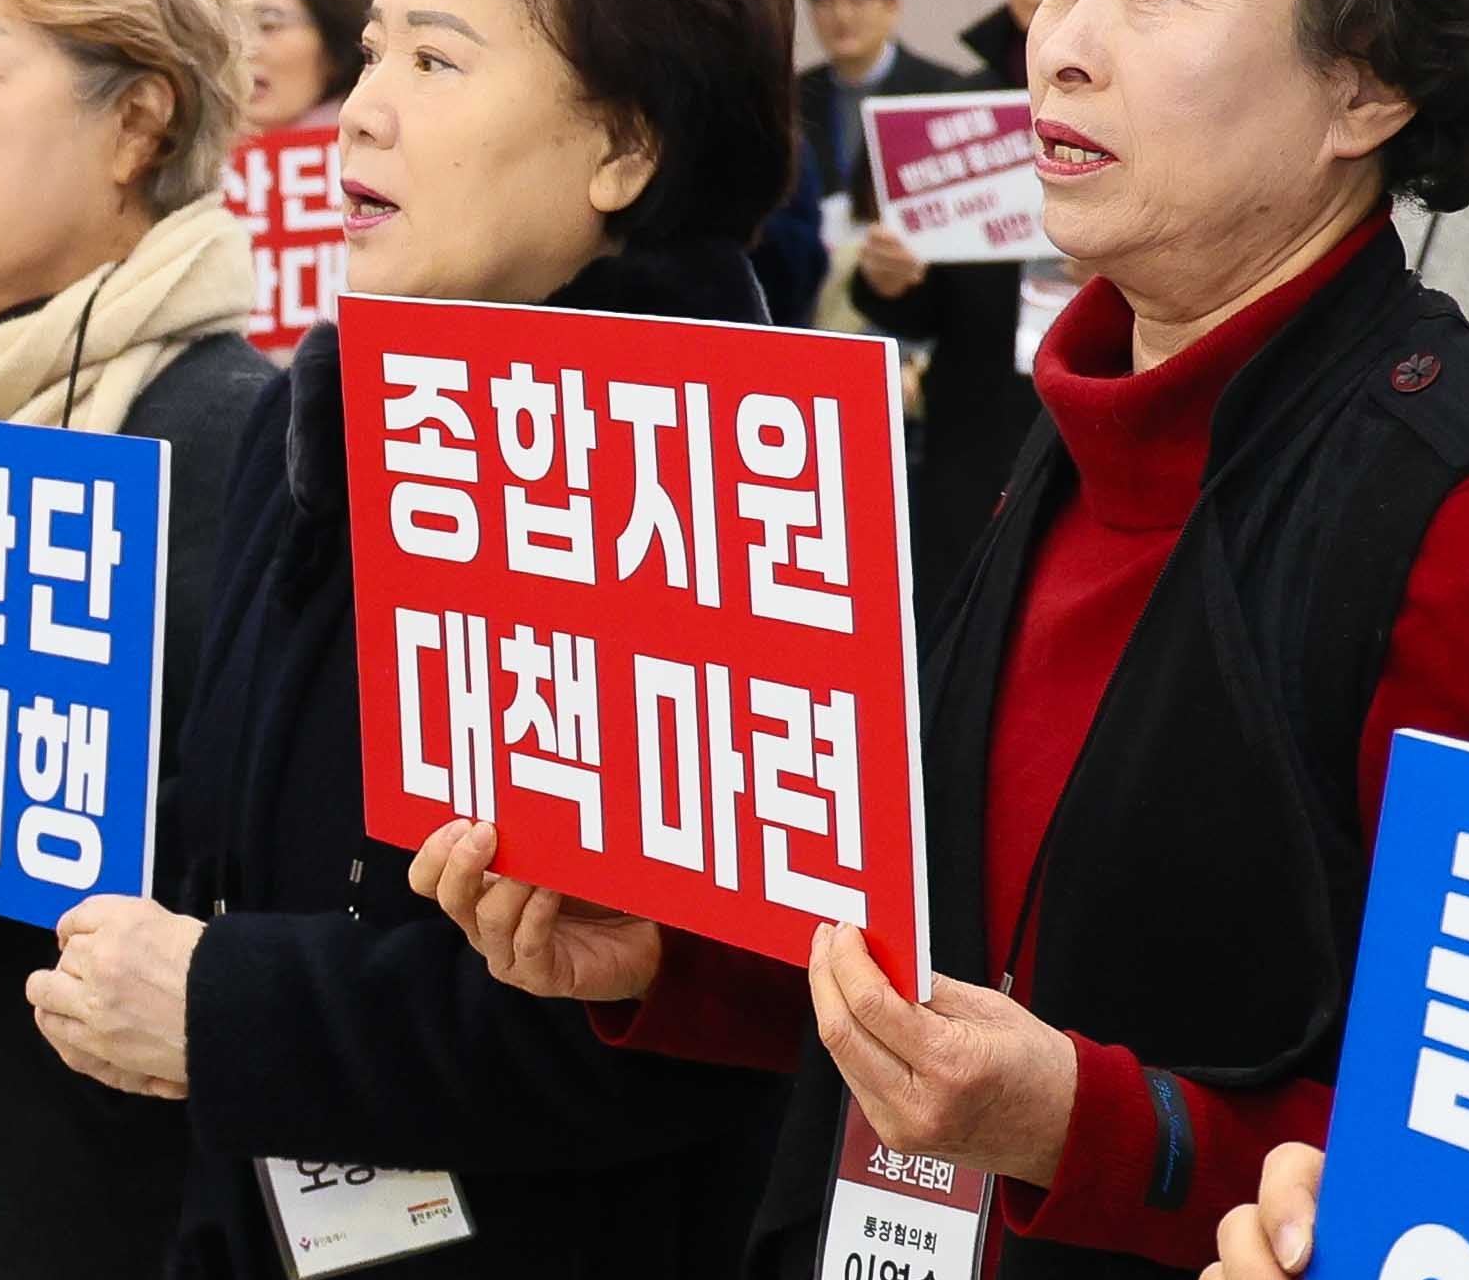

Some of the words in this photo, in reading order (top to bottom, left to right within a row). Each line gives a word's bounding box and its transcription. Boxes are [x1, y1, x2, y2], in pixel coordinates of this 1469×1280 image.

[221, 144, 344, 232] 산단
[382, 352, 854, 634] 종합지원
[394, 607, 605, 853] 대책
[633, 653, 868, 929] 마련
[867, 1144, 955, 1194] 소통간담회
[863, 1216, 938, 1254] 통장협의회
